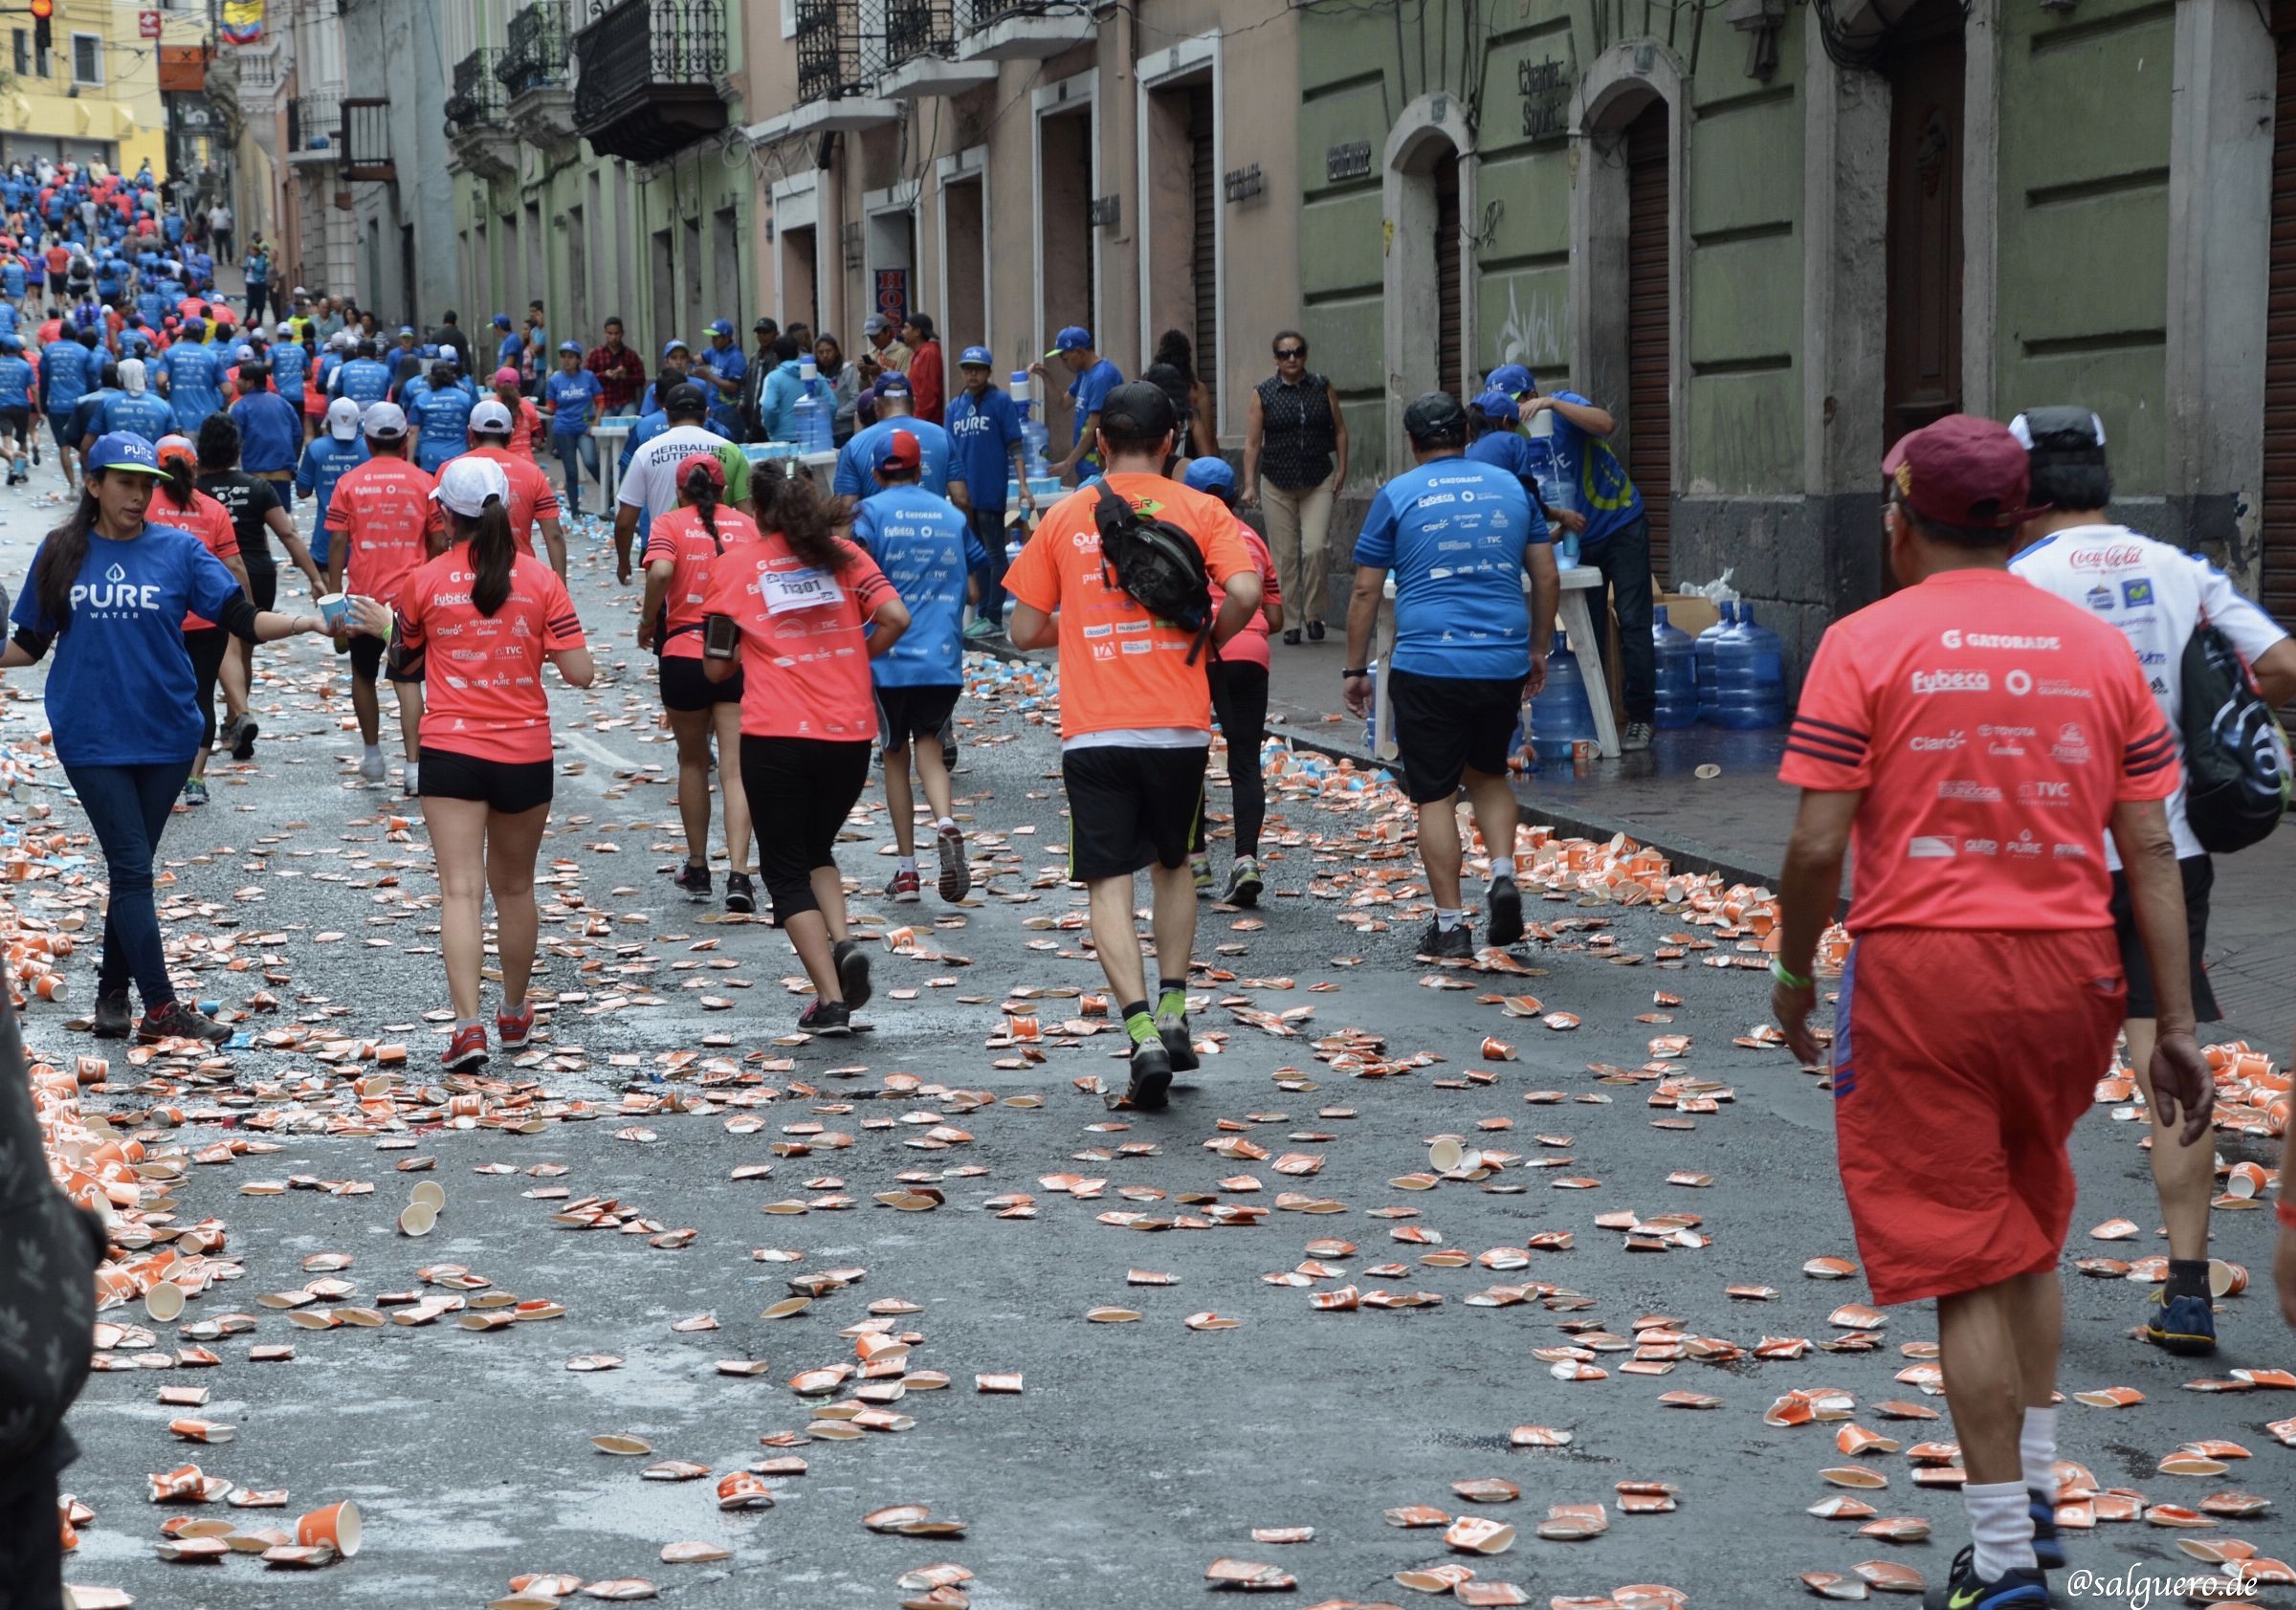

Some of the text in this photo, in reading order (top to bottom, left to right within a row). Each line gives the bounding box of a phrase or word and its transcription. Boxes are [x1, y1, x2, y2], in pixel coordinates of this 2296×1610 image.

[954, 416, 990, 434] PURE
[651, 443, 727, 458] HERBALIFE
[70, 584, 161, 610] PURE
[1966, 633, 2061, 650] GATORADE
[505, 646, 521, 654] TVC
[1911, 669, 1990, 694] Fybeca
[1991, 725, 2036, 737] TOYOTA
[1910, 730, 1967, 751] Claro
[2037, 782, 2070, 797] TVC
[2007, 842, 2042, 853] PURE
